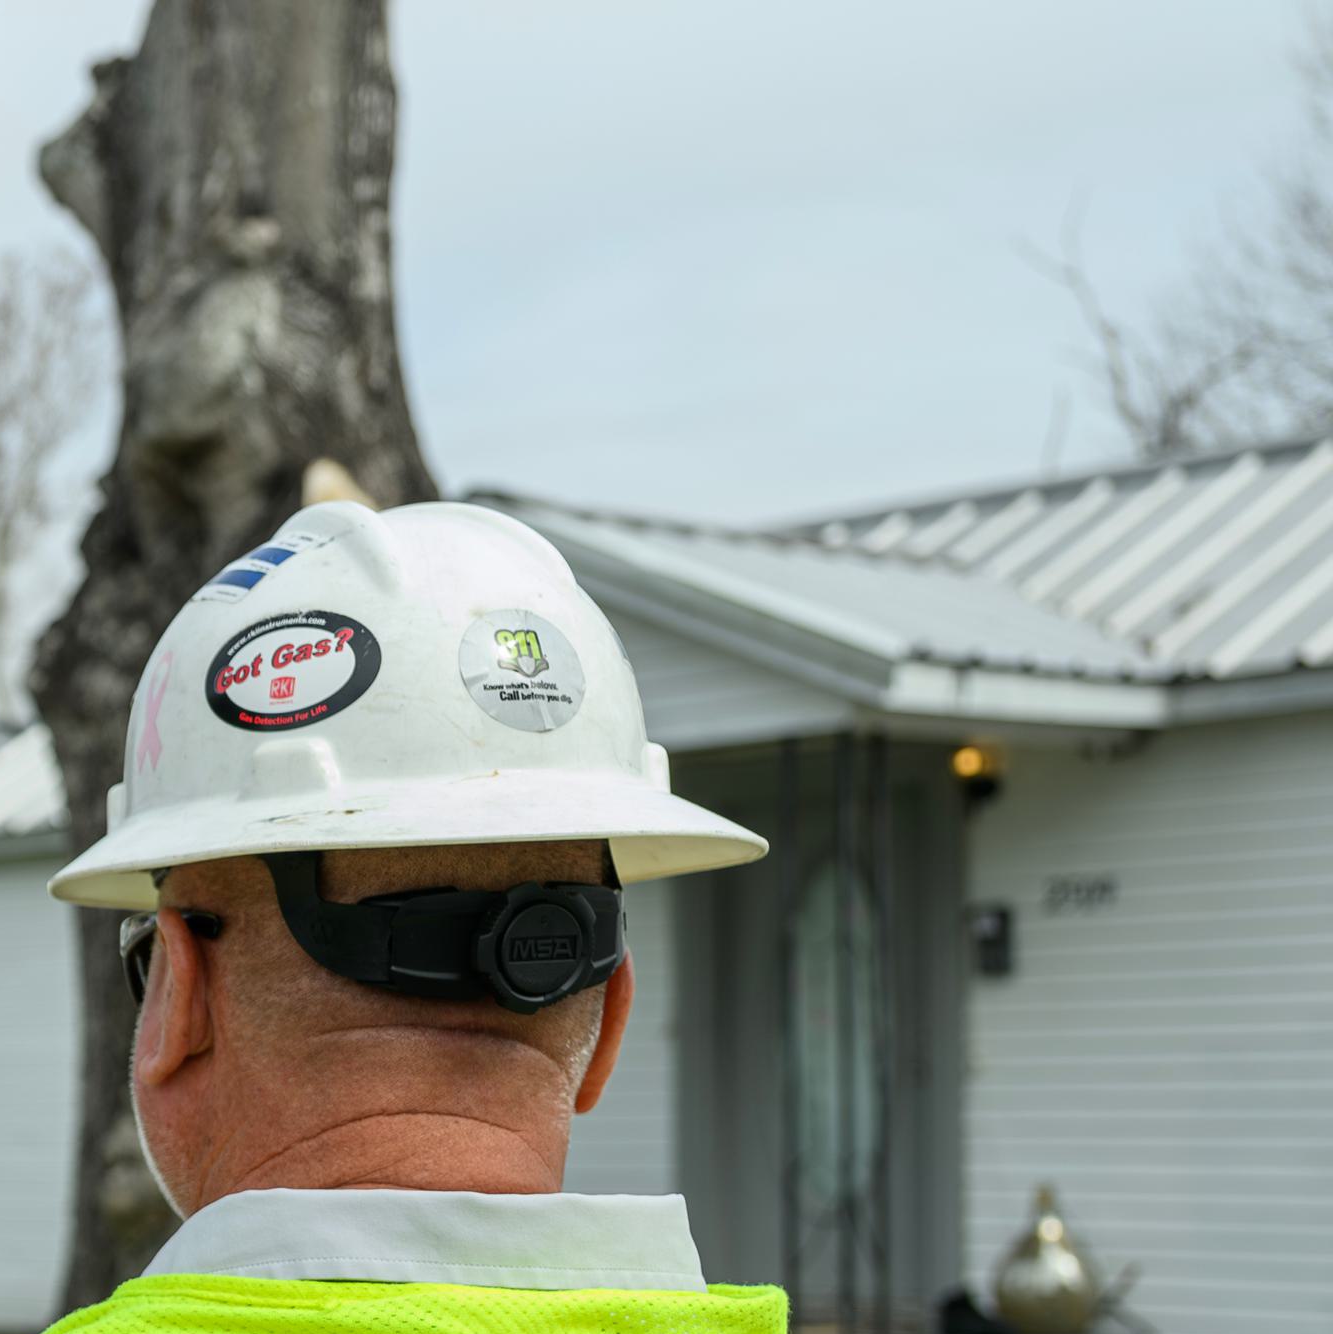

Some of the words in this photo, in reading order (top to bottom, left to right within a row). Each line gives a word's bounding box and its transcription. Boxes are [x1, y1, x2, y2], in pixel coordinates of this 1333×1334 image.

[494, 629, 543, 662] 811
[215, 653, 263, 694] Got
[271, 627, 355, 669] Gas?
[271, 677, 295, 698] RKI
[505, 682, 529, 690] what's
[530, 680, 558, 690] below.
[499, 691, 520, 701] Call
[521, 692, 545, 701] before
[546, 694, 559, 702] you
[238, 710, 253, 723] Gas
[254, 715, 293, 726] Detection
[294, 711, 309, 722] For
[310, 704, 328, 717] Life
[513, 938, 573, 960] MSA
